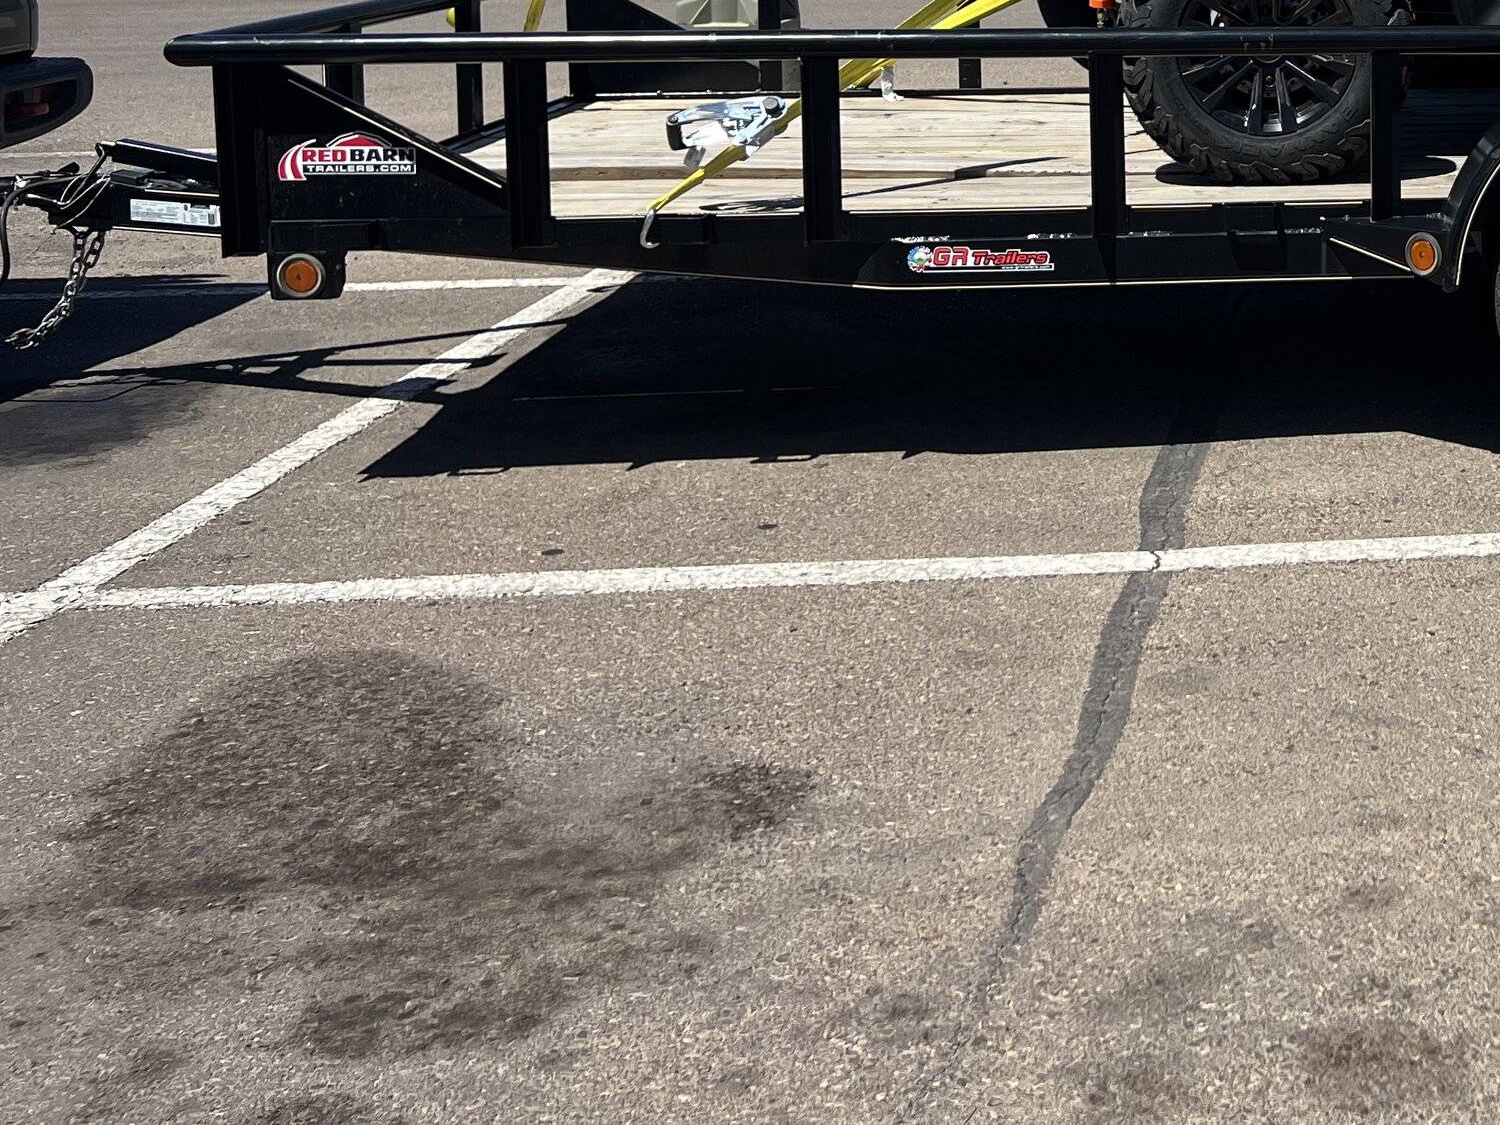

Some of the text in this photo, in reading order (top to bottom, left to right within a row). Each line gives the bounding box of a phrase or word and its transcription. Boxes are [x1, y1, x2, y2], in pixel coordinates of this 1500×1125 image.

[306, 164, 412, 173] TRAILERS.COM
[933, 246, 1048, 266] GR Trailers
